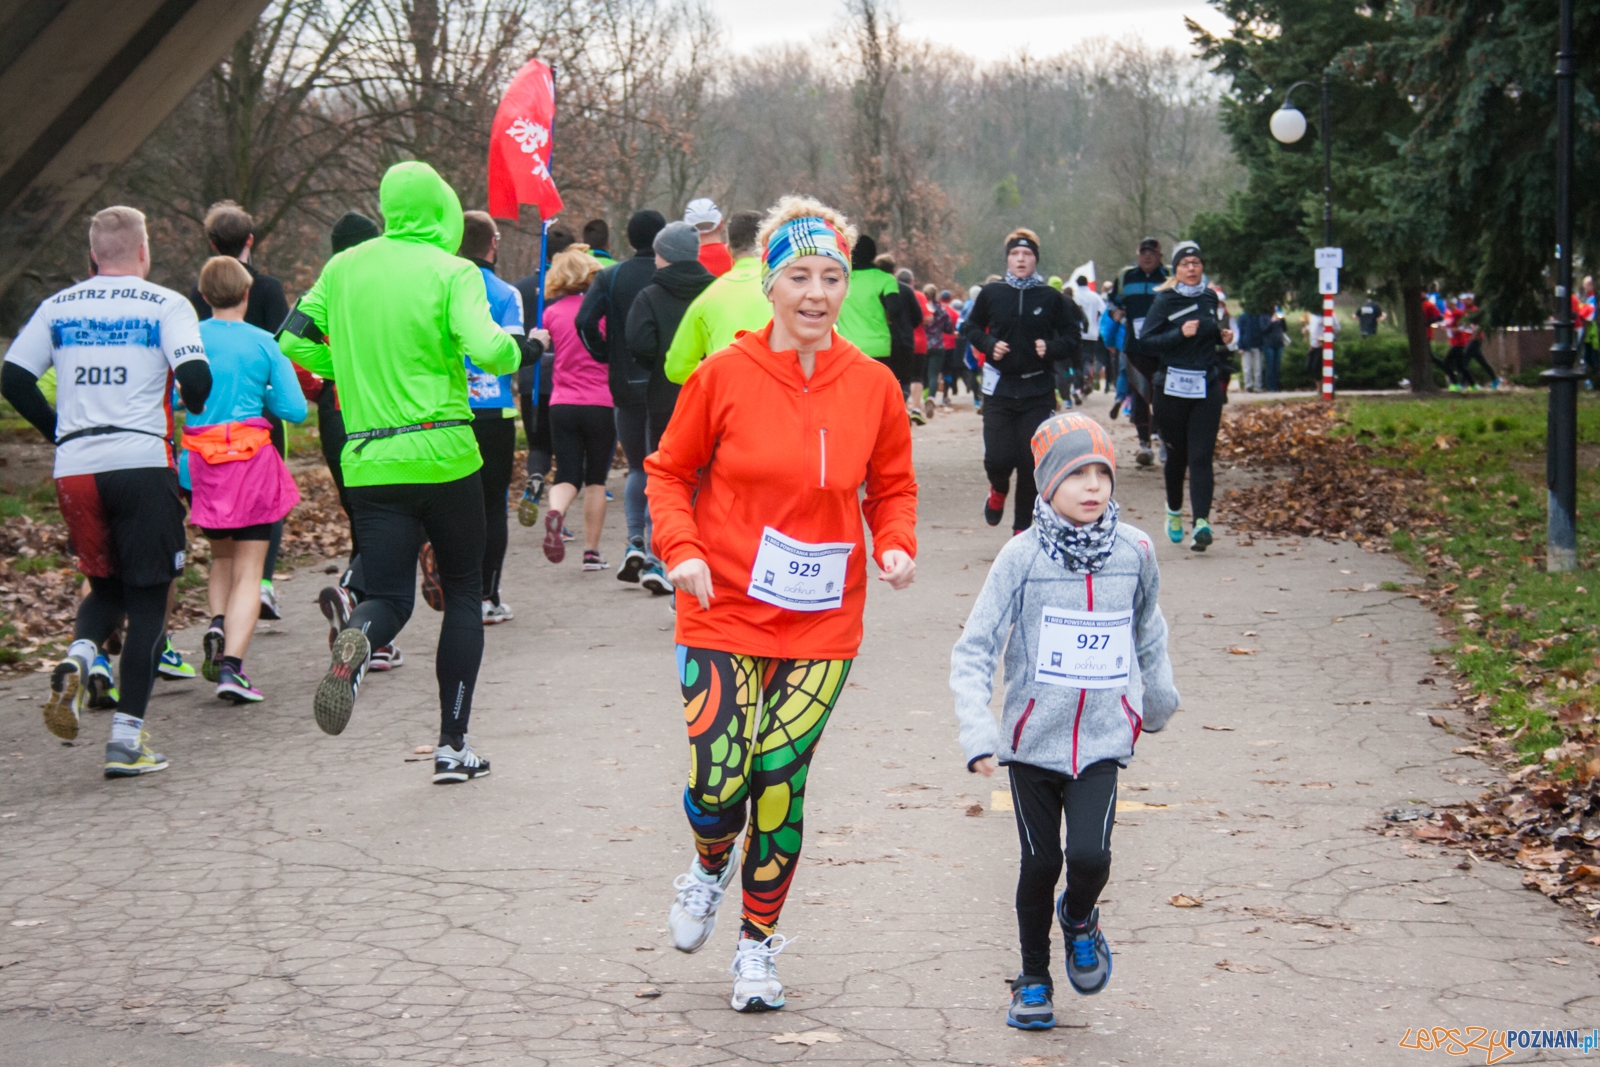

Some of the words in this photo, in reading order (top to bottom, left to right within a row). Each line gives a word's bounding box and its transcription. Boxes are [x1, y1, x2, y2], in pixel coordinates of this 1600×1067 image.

[110, 288, 167, 306] POLSKI
[74, 366, 128, 385] 2013
[396, 424, 422, 435] gdynia
[787, 560, 821, 578] 929
[783, 581, 816, 595] parkrun
[1063, 618, 1096, 627] POWSTANIA
[1076, 633, 1111, 650] 927
[1074, 655, 1107, 670] parkrun
